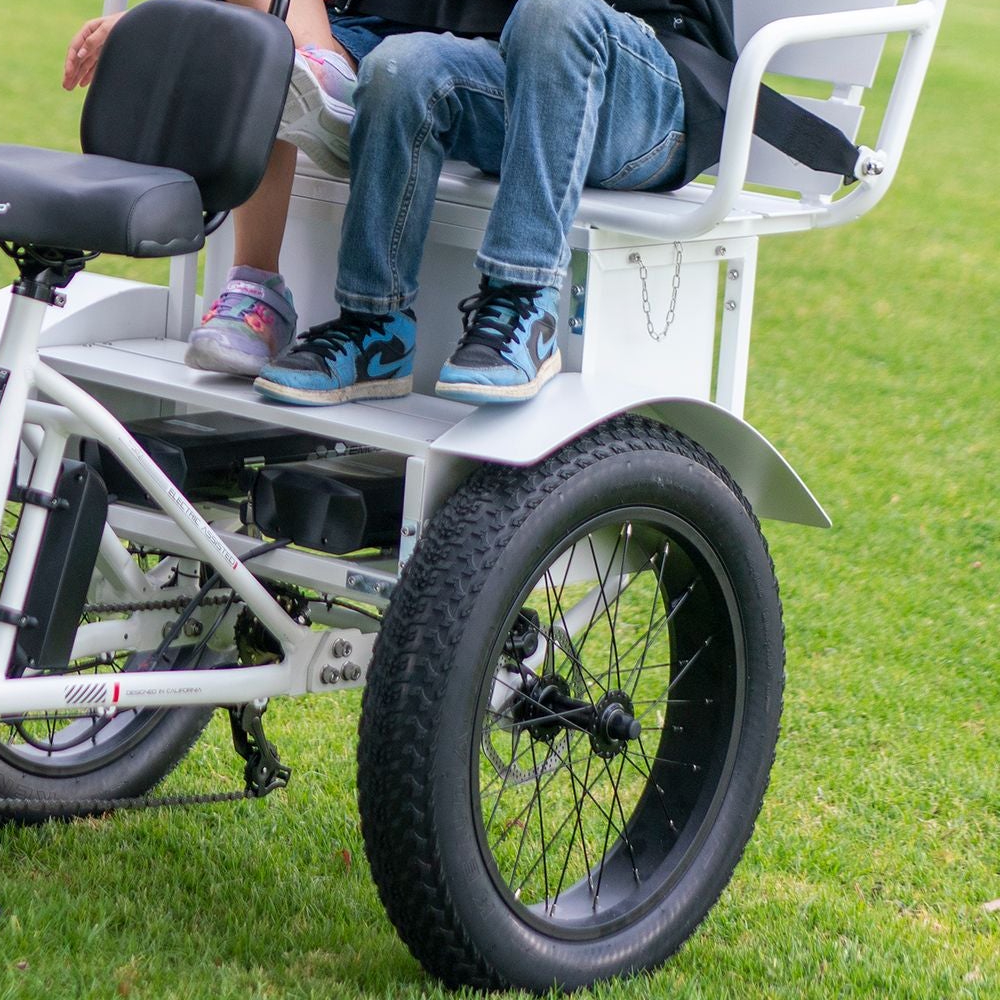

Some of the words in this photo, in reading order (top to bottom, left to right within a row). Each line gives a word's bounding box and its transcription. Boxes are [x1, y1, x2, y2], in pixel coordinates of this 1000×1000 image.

[168, 486, 201, 527] ELECTRIC
[201, 526, 236, 565] ASSISTED
[126, 688, 157, 696] DESIGNED
[166, 686, 202, 695] CALIFORNIA
